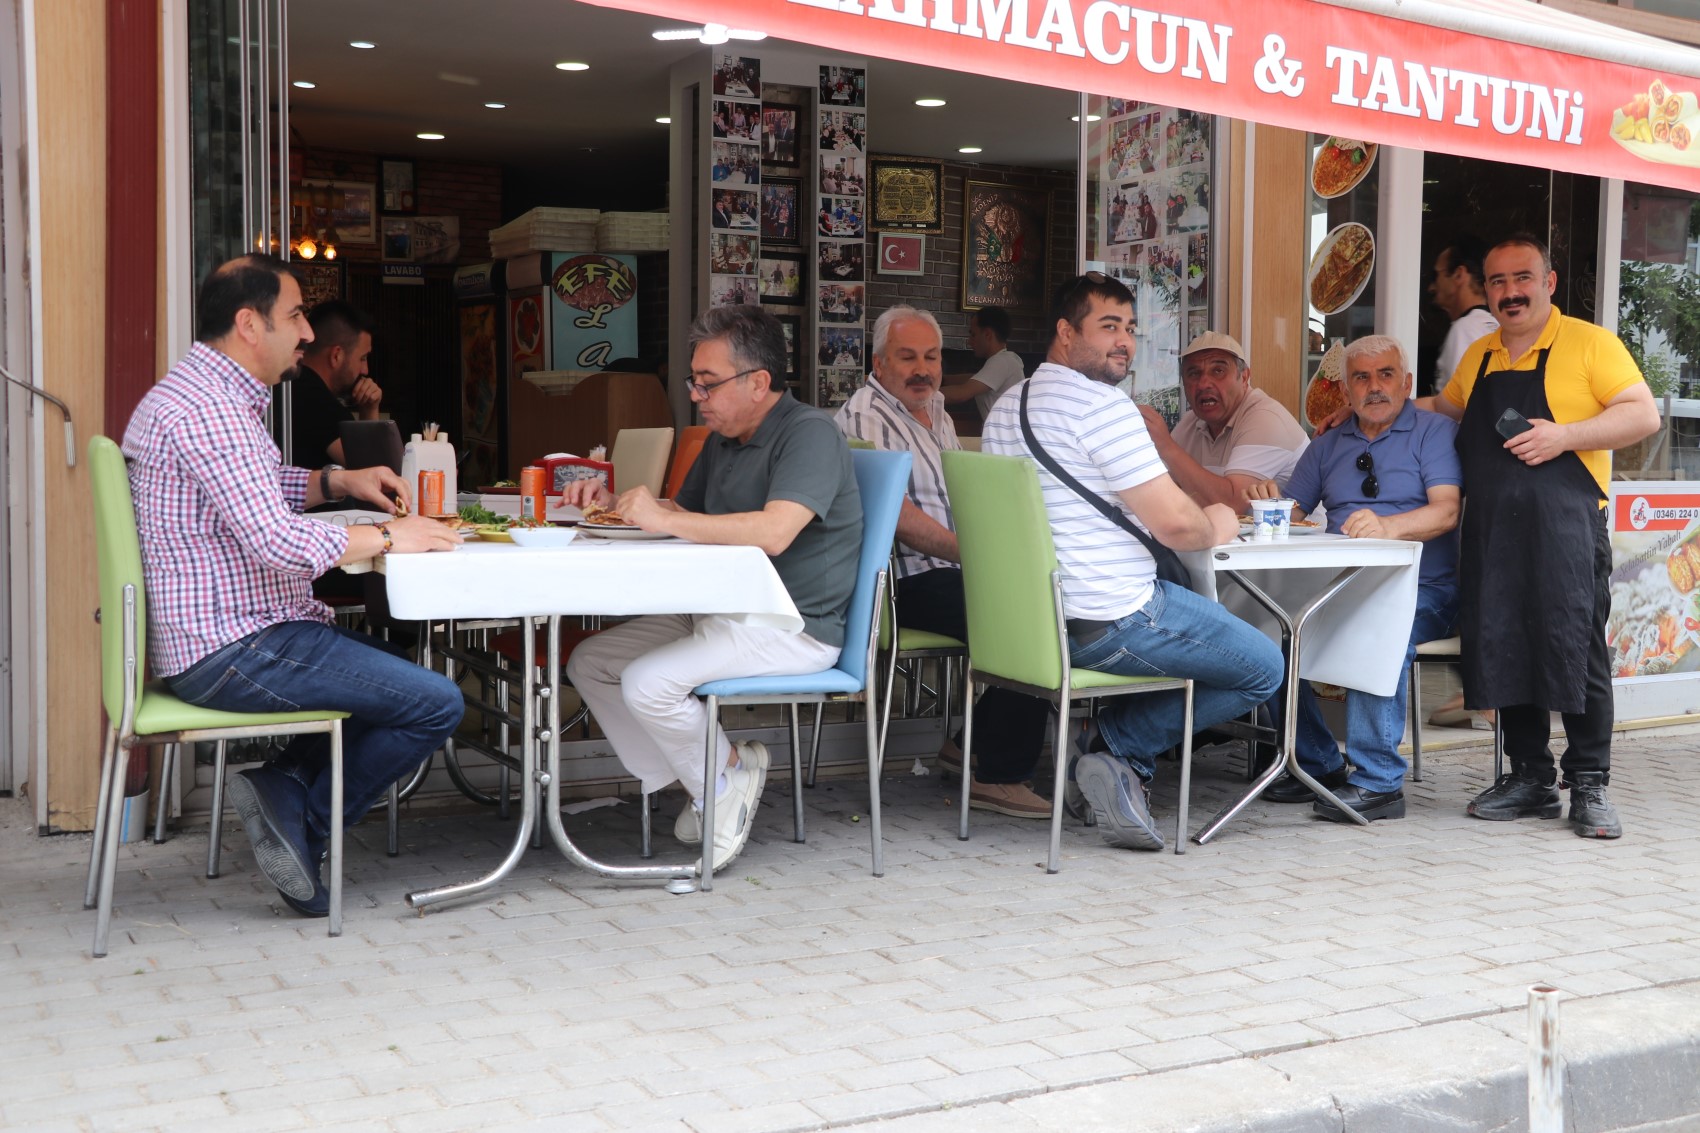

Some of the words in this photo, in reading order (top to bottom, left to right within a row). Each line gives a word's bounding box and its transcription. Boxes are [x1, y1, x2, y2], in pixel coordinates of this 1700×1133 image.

[787, 0, 1233, 84] MACUN
[1253, 33, 1305, 98] &
[384, 265, 422, 276] LAVABO
[556, 263, 633, 300] EFE
[1653, 509, 1677, 520] (0346)
[1679, 509, 1692, 518] 224
